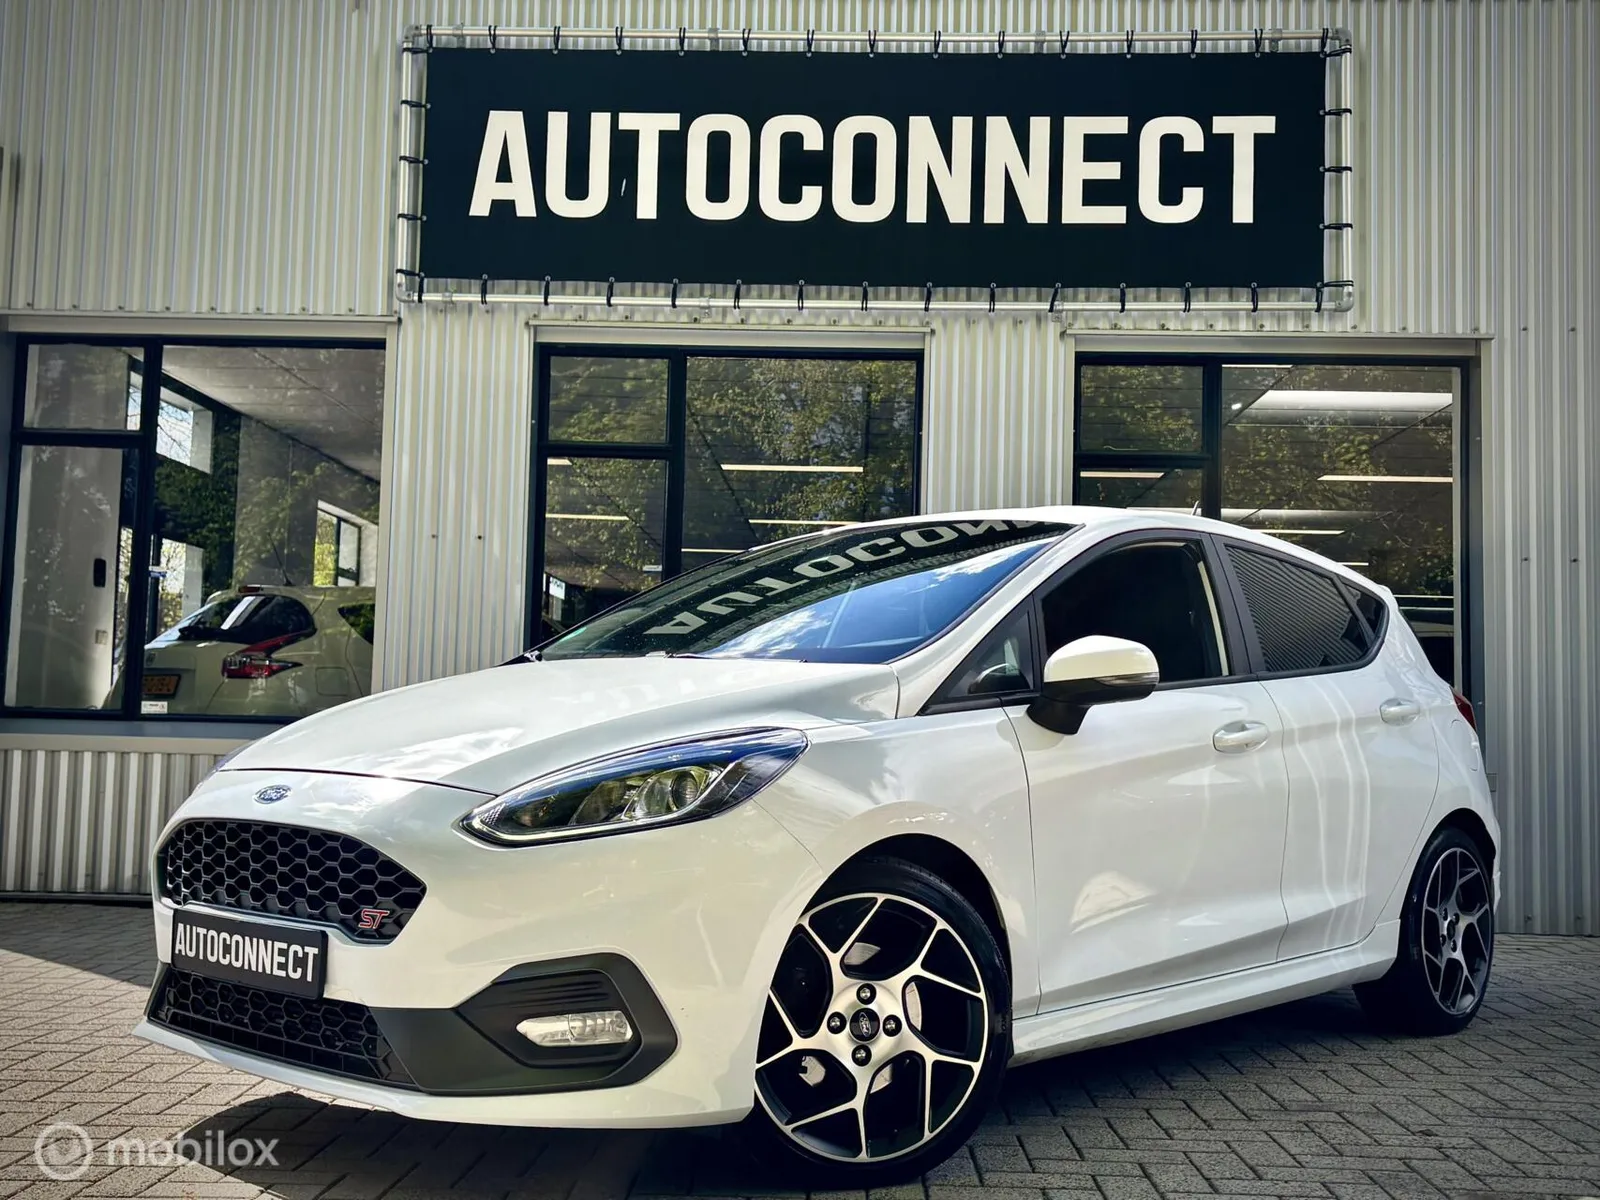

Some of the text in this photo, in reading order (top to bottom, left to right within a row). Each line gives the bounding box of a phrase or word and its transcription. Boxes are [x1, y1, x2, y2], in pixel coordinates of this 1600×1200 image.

[469, 111, 1276, 224] AUTOCONNECT
[358, 908, 390, 929] ST
[174, 922, 319, 982] AUTOCONNECT
